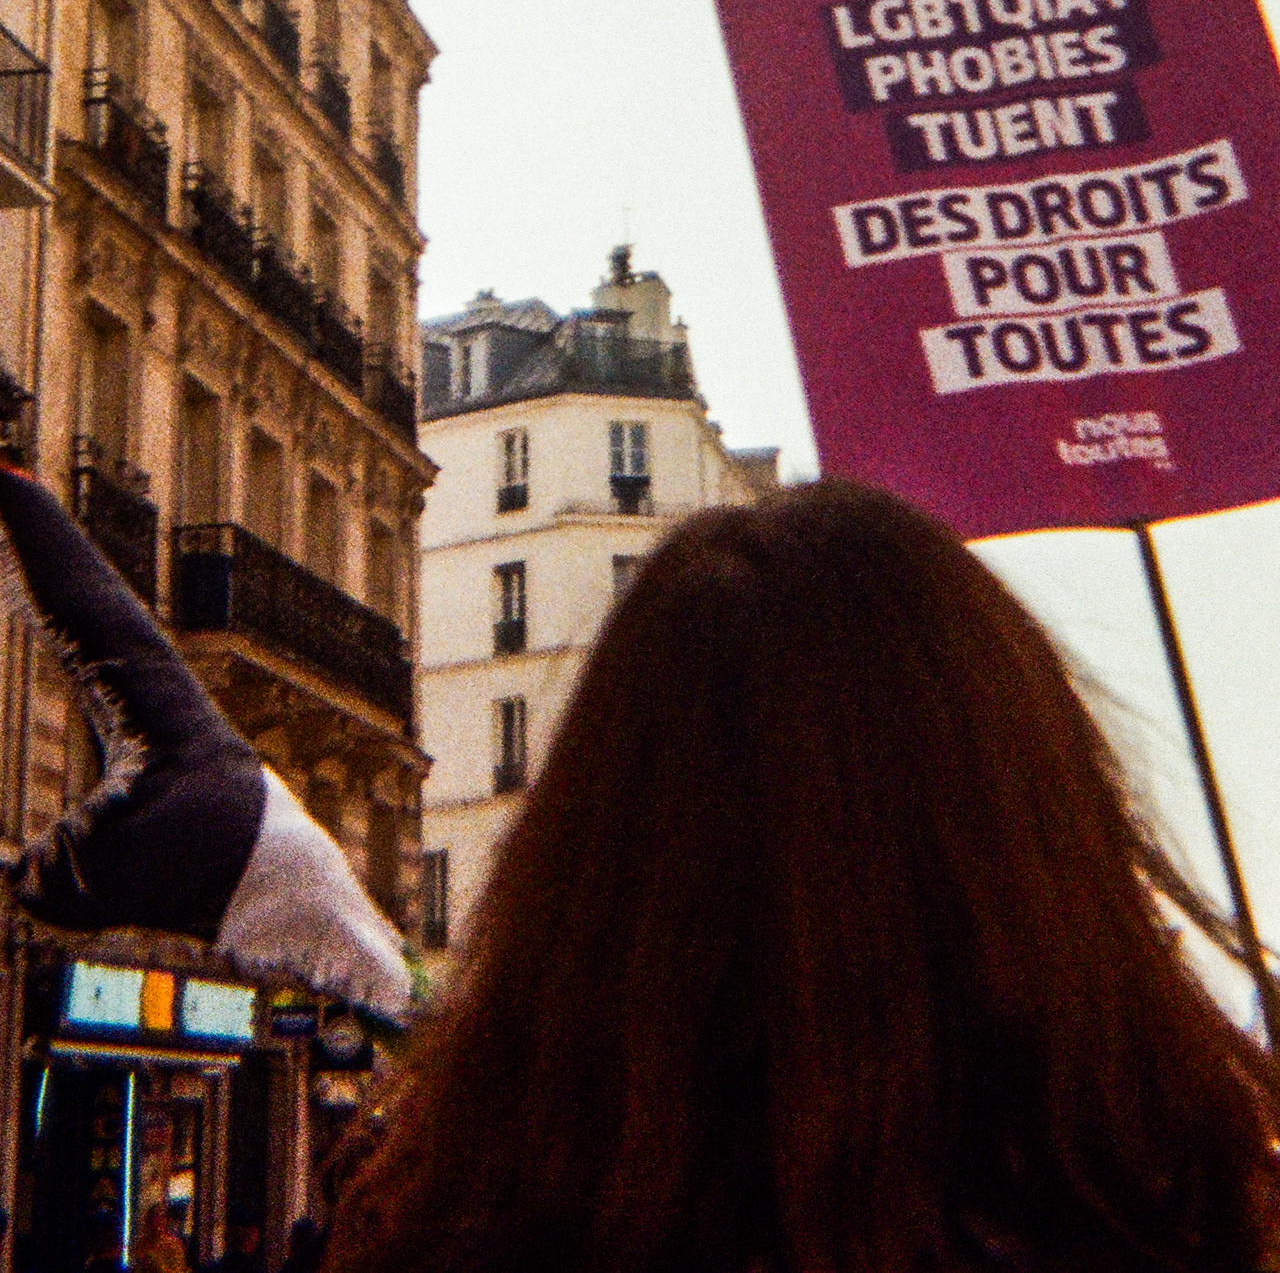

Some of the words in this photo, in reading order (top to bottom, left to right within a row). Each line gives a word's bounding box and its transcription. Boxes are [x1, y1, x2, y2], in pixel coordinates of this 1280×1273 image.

[865, 26, 1126, 102] PHOBIES
[909, 92, 1117, 163] TUENT
[851, 193, 980, 257] DES
[985, 153, 1230, 240] DROITS
[966, 242, 1158, 308] POUR
[946, 302, 1213, 379] TOUTES
